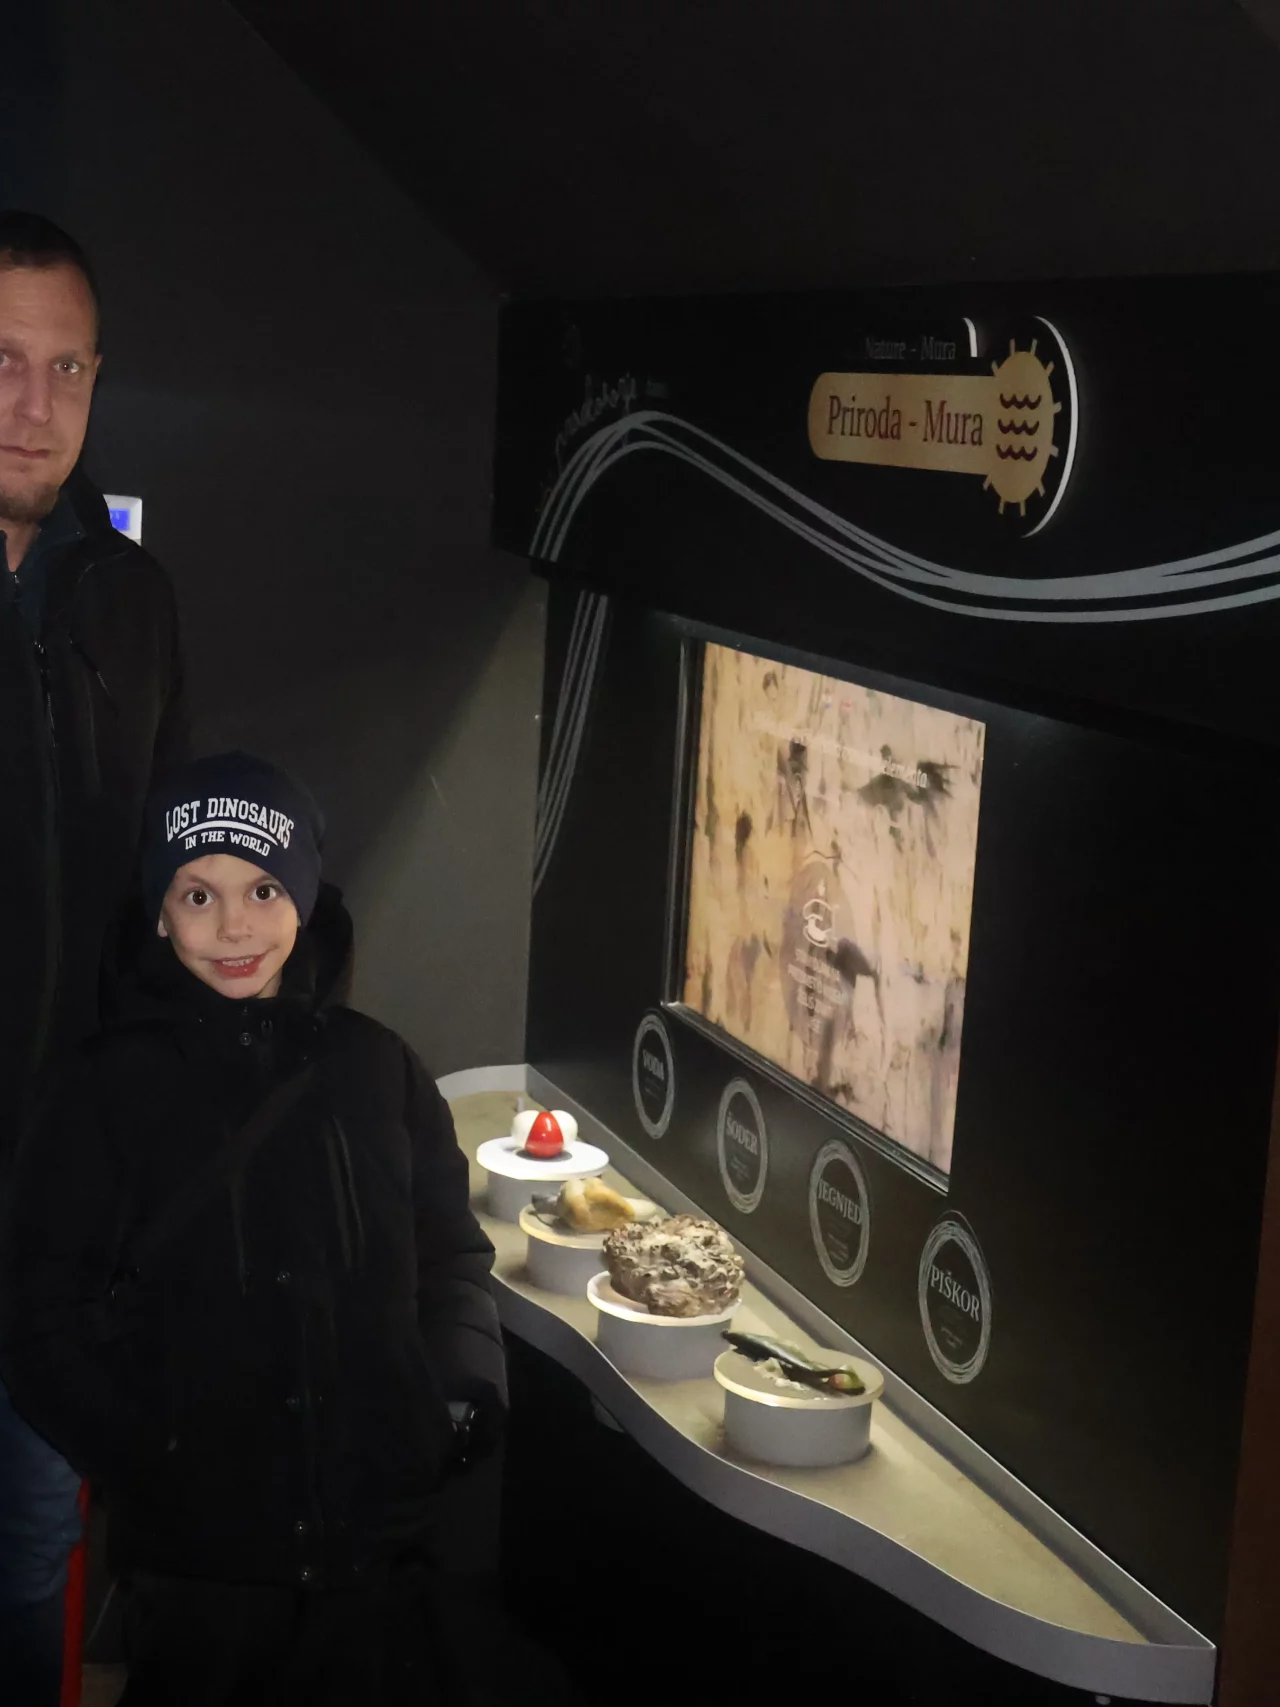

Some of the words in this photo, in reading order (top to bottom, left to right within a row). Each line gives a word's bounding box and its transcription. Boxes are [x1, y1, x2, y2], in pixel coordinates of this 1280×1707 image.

[864, 337, 906, 360] Nature
[920, 336, 957, 361] Mura
[827, 395, 902, 440] Priroda
[923, 400, 983, 446] Mura
[165, 800, 201, 843] LOST
[207, 797, 295, 849] DINOSAURS
[185, 835, 197, 850] IN
[201, 831, 225, 844] THE
[229, 833, 271, 857] WORLD
[817, 1181, 861, 1226] JEGNJED
[930, 1265, 981, 1321] PIŠKOR
